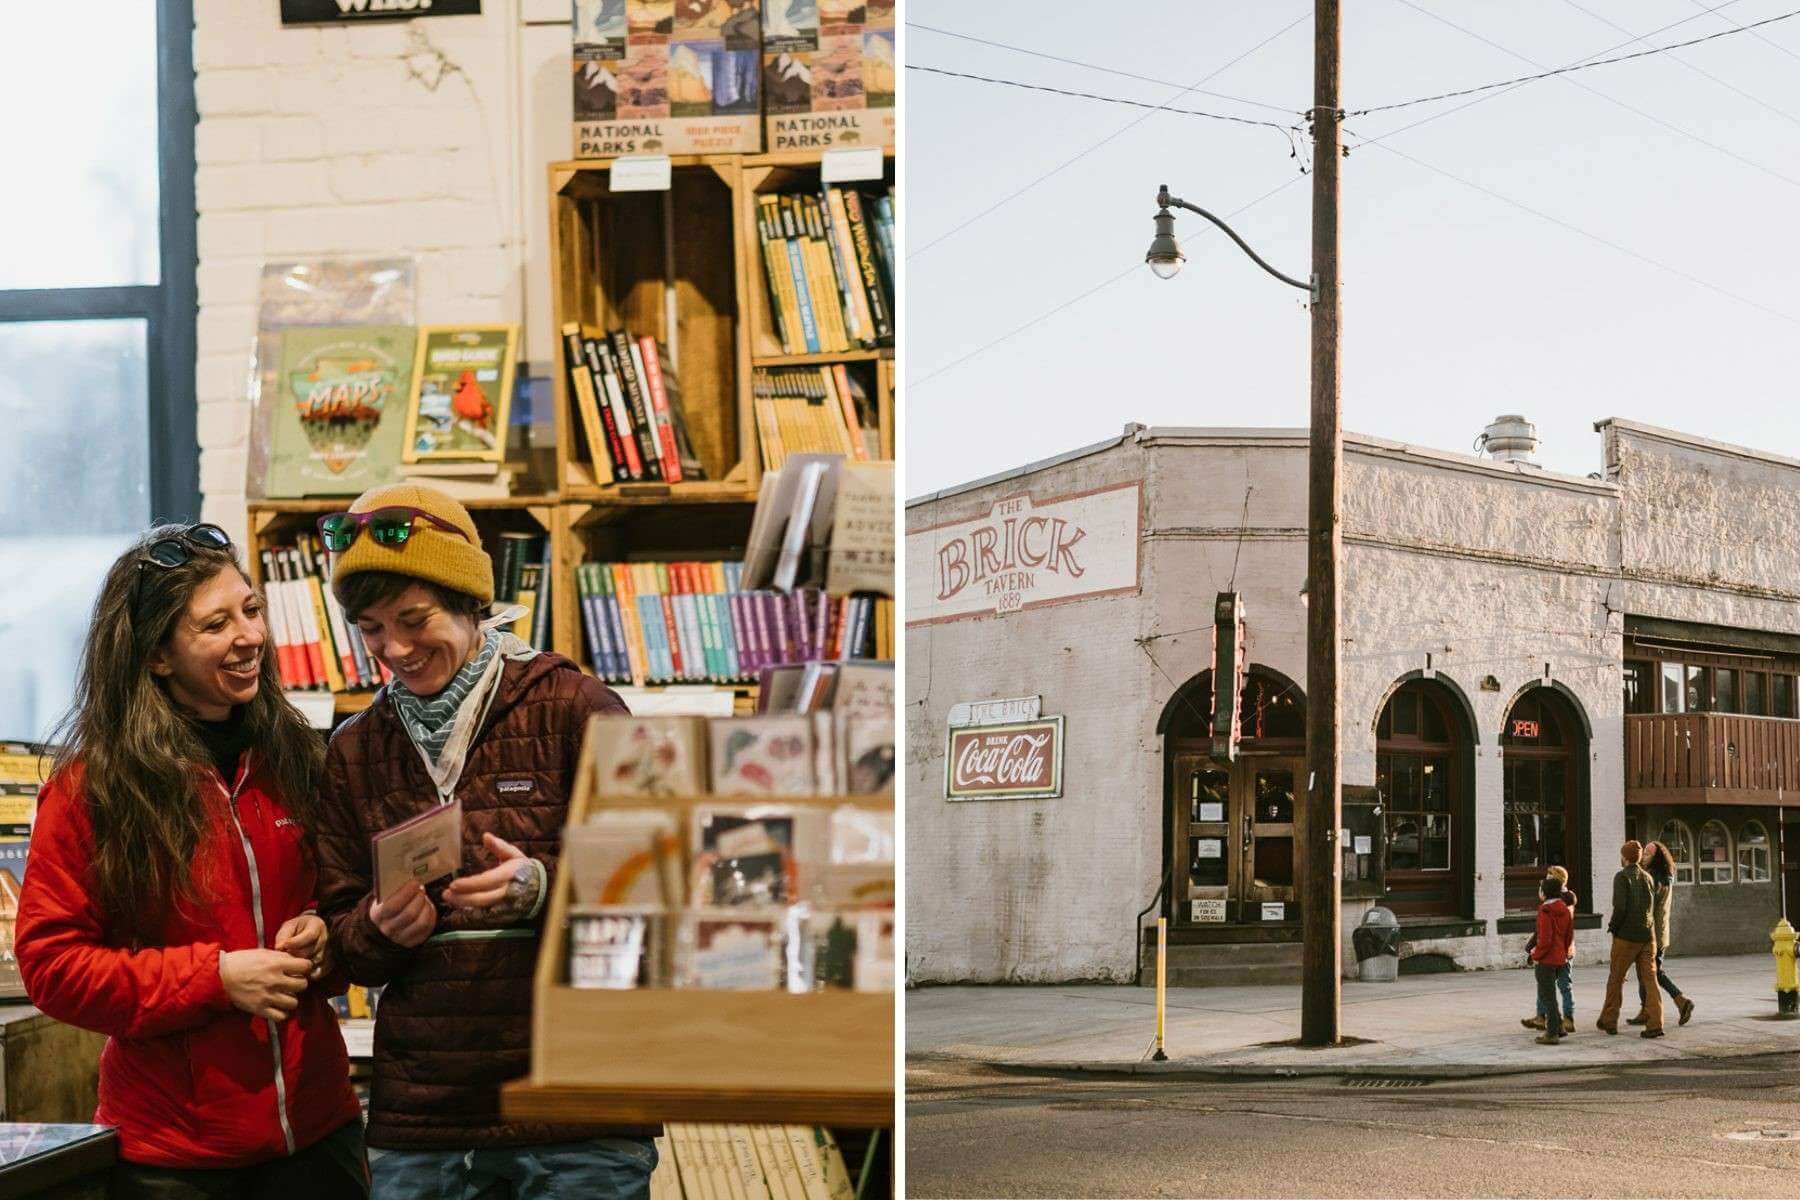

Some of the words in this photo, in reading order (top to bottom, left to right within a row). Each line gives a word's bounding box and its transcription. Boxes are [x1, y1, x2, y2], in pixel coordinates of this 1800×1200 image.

[580, 125, 664, 139] NATIONAL
[776, 115, 860, 133] NATIONAL
[580, 140, 636, 154] PARKS
[776, 132, 833, 149] PARKS
[303, 373, 384, 418] MAPS
[999, 500, 1023, 515] THE
[936, 517, 1086, 600] BRICK
[984, 571, 1034, 595] TAVERN
[1512, 720, 1539, 736] OPEN
